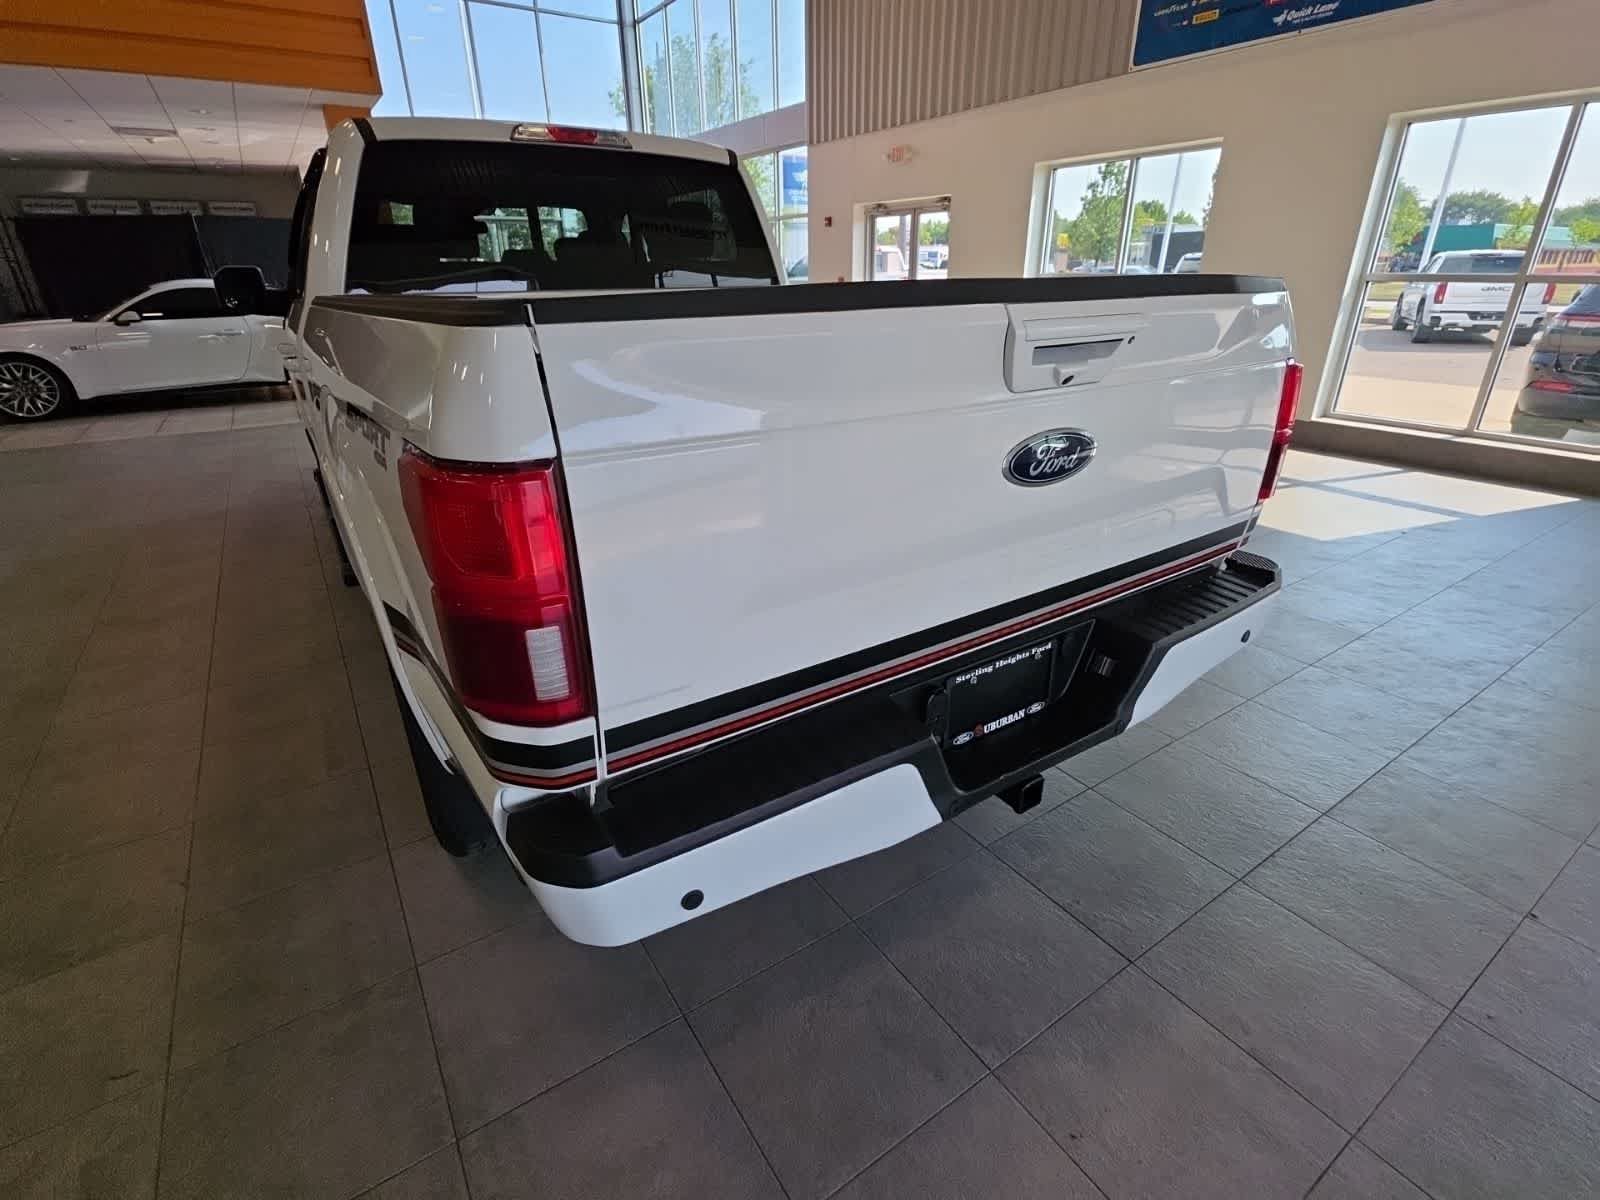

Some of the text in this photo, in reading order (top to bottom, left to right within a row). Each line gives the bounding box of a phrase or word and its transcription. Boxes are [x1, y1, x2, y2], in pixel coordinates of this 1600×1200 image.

[1286, 6, 1313, 21] Quick
[1312, 1, 1340, 14] Lane
[1029, 442, 1081, 477] Ford
[955, 641, 1052, 684] Sterling Heights Ford
